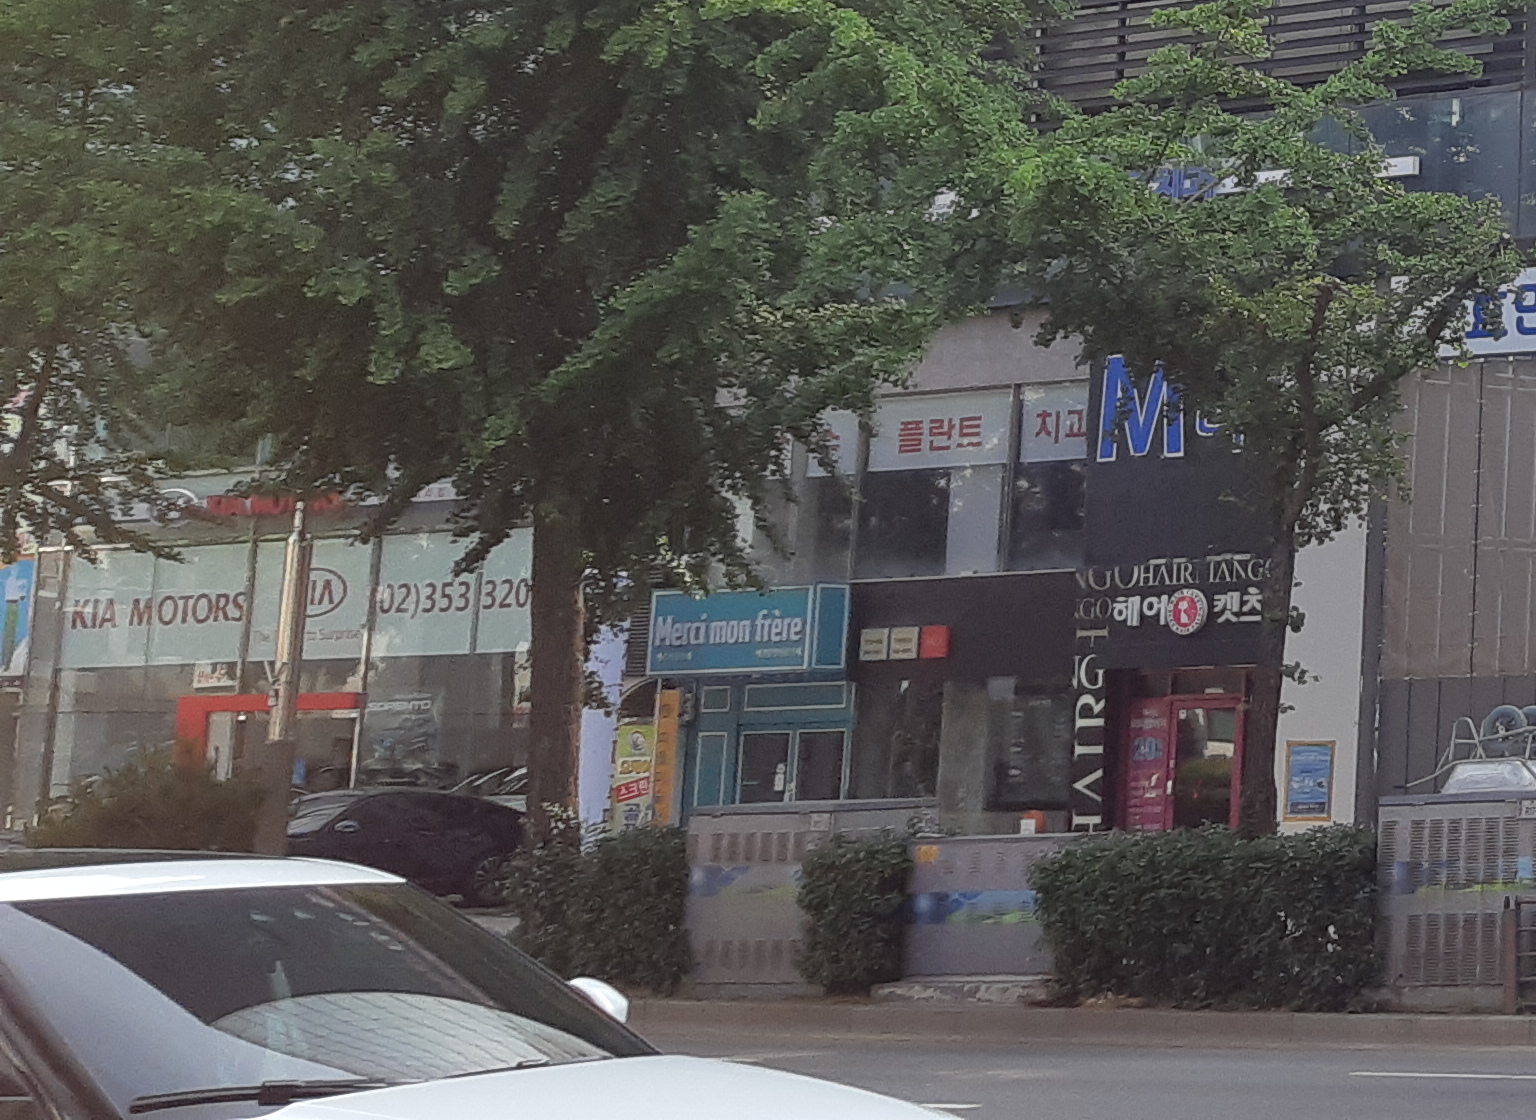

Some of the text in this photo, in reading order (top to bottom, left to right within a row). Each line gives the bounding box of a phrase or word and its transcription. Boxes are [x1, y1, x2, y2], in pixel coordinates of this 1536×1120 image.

[898, 414, 983, 454] 플란트
[71, 597, 118, 631] KIA
[129, 591, 247, 628] MOTORS
[1112, 594, 1169, 627] 헤어
[654, 612, 704, 647] Merci
[708, 618, 751, 645] mon
